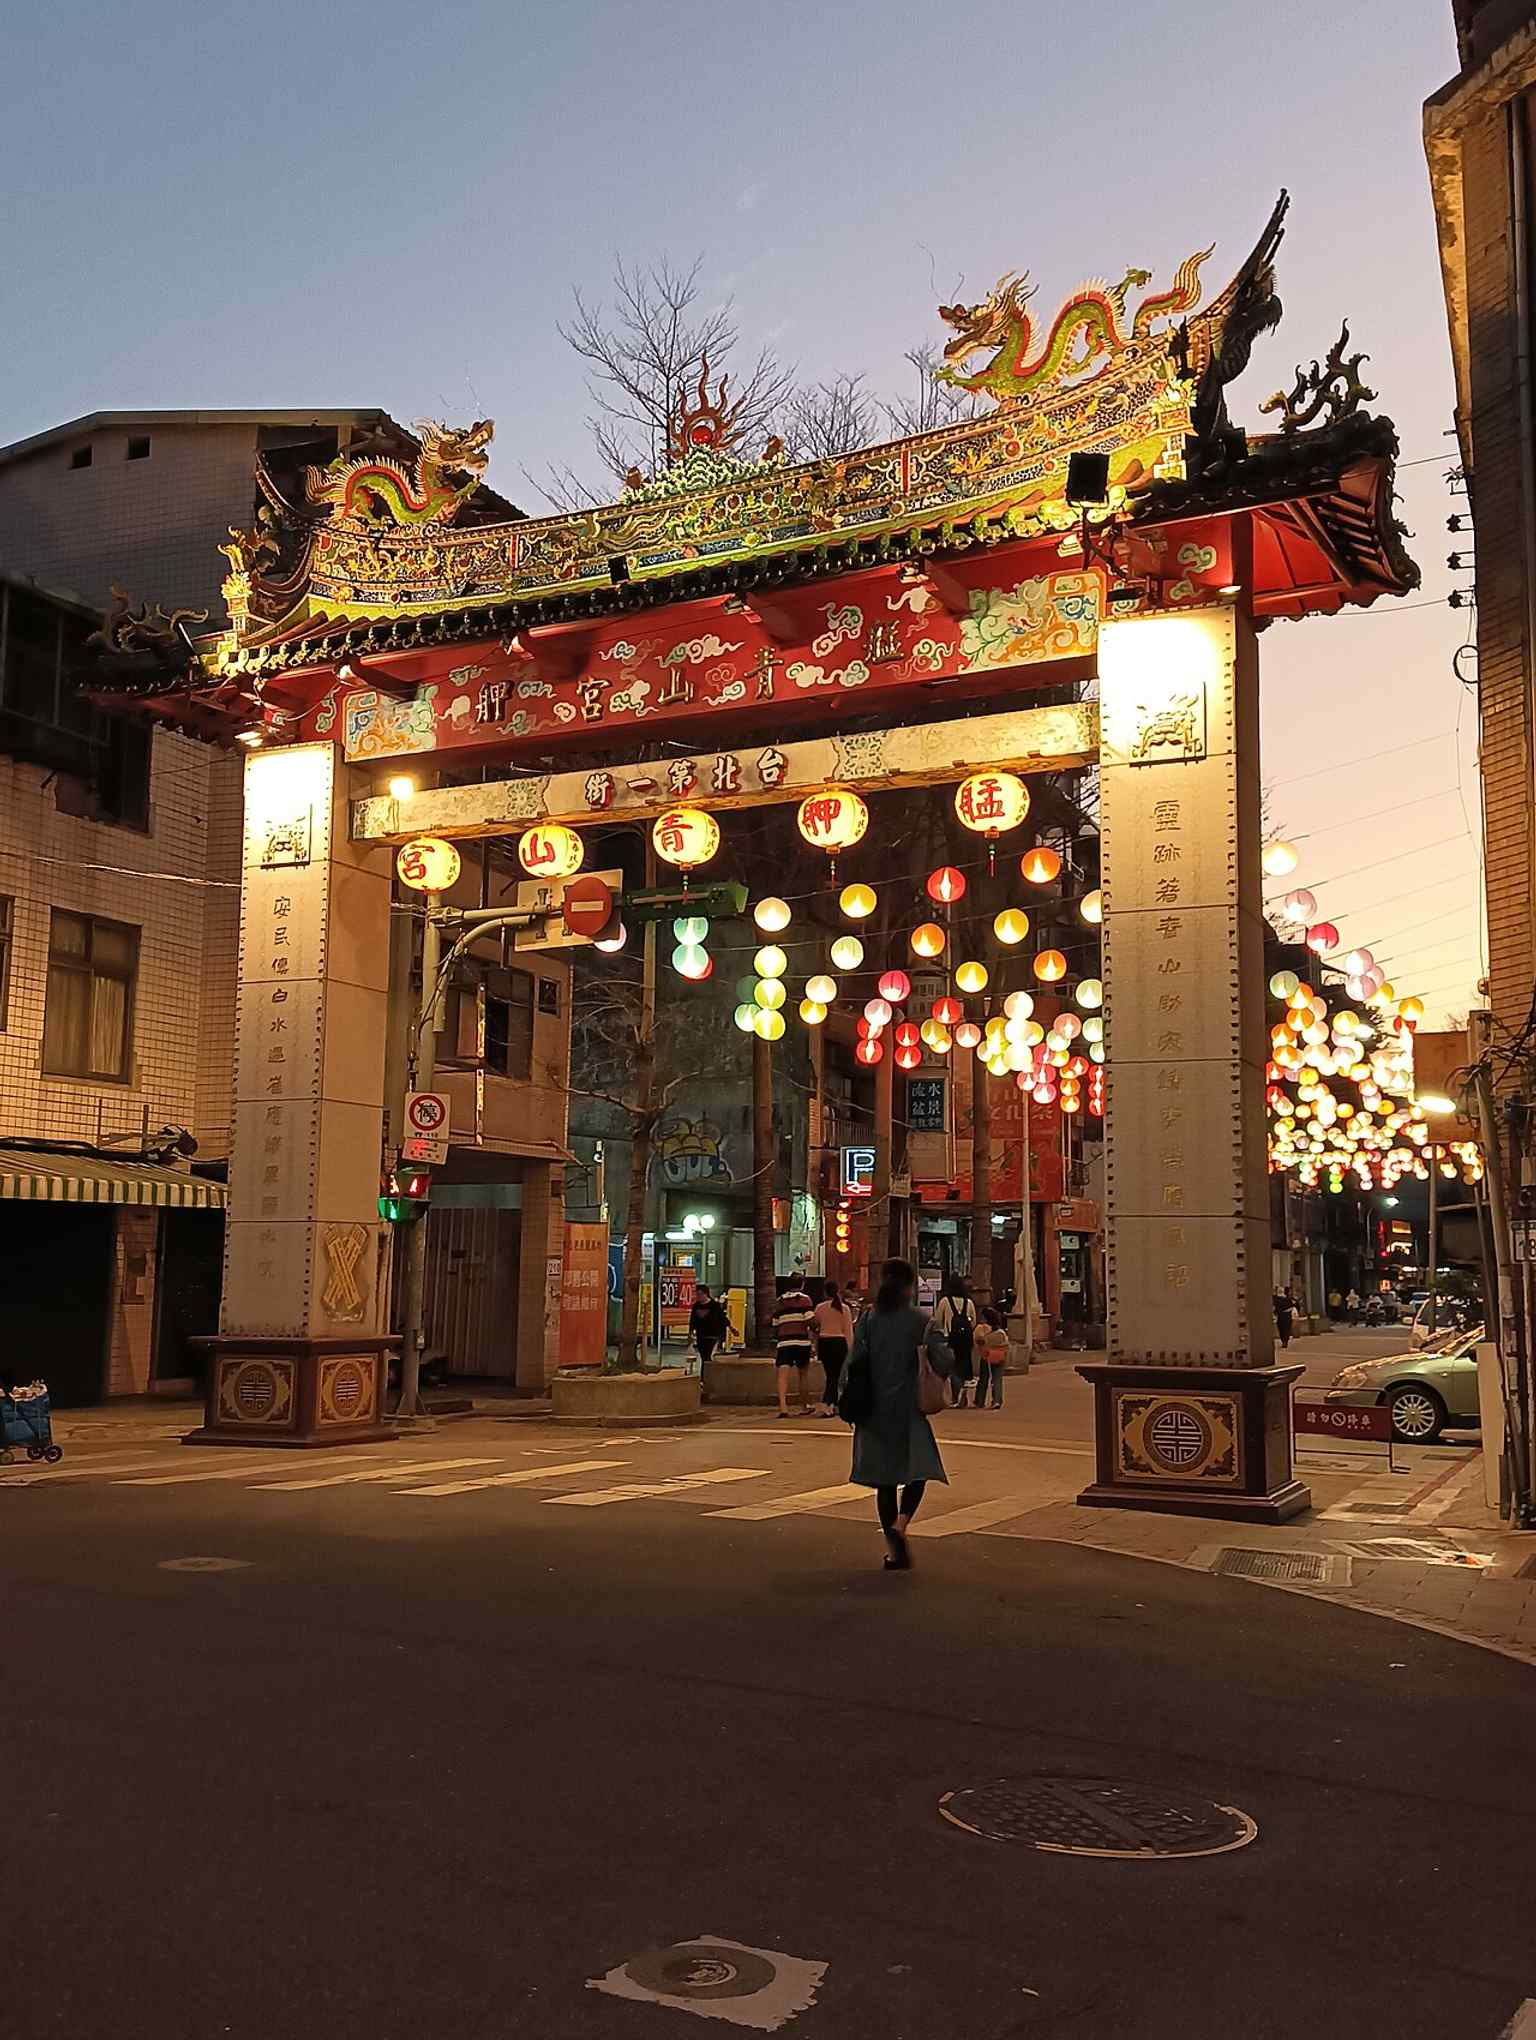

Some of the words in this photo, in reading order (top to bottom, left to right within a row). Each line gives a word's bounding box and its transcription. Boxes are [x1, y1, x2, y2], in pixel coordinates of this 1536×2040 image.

[522, 833, 555, 867] 山
[656, 814, 693, 852] 青
[399, 843, 435, 880] 宮
[846, 1149, 876, 1184] P
[662, 1283, 675, 1305] 30
[680, 1284, 692, 1305] 40
